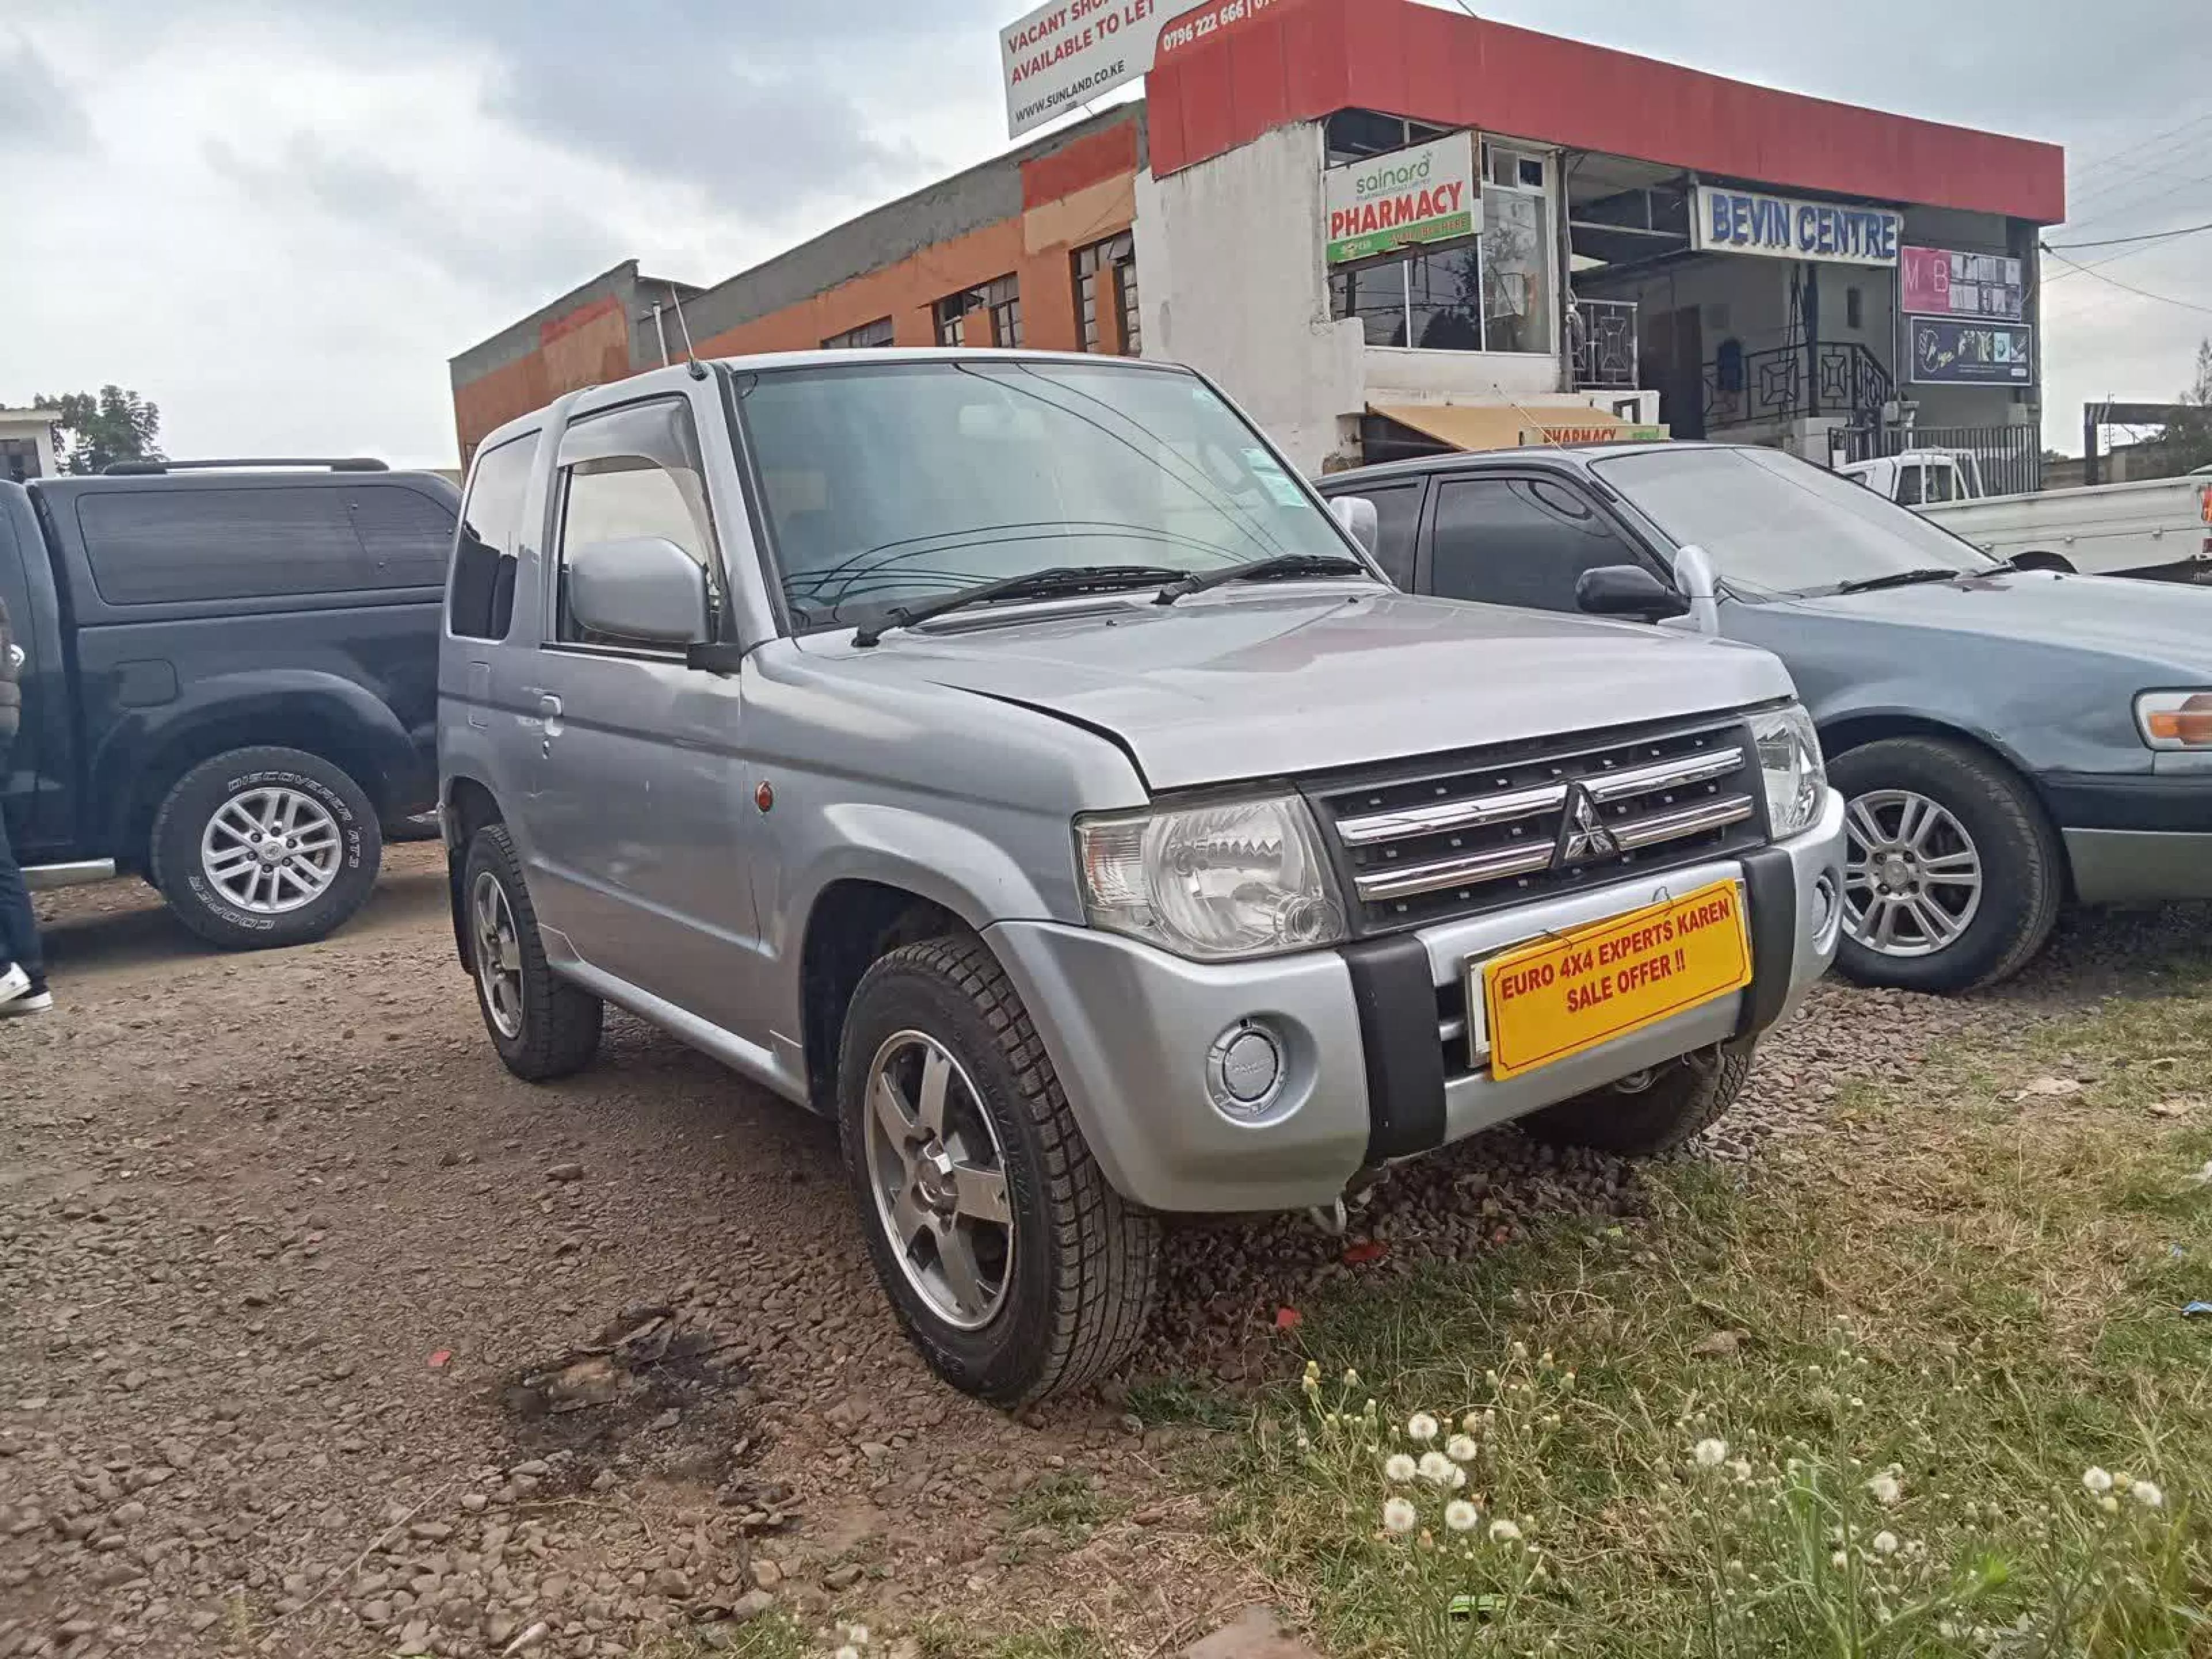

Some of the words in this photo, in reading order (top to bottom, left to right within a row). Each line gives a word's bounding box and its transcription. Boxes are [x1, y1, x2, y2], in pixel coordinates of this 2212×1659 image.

[1008, 8, 1067, 54] VACANT
[1071, 0, 1108, 20] SH
[1012, 29, 1093, 86] AVAILABLE
[1096, 13, 1119, 39] TO
[1125, 0, 1154, 26] LET
[1195, 13, 1217, 37] 222
[1016, 59, 1124, 123] WWW.SUNLAND.CO.KE
[1331, 180, 1463, 240] PHARMACY
[1711, 194, 1790, 248] BEVIN
[1798, 205, 1896, 258] CENTRE
[228, 771, 353, 821] DISCOVERER
[188, 876, 275, 930] COOPER
[1501, 964, 1554, 1000] EURO
[1560, 953, 1594, 978] 4X4
[1599, 921, 1673, 965] EXPERTS
[1677, 898, 1730, 935] KAREN
[1567, 977, 1613, 1012] SALE
[1618, 955, 1670, 994] OFFER
[1676, 948, 1685, 972] !!
